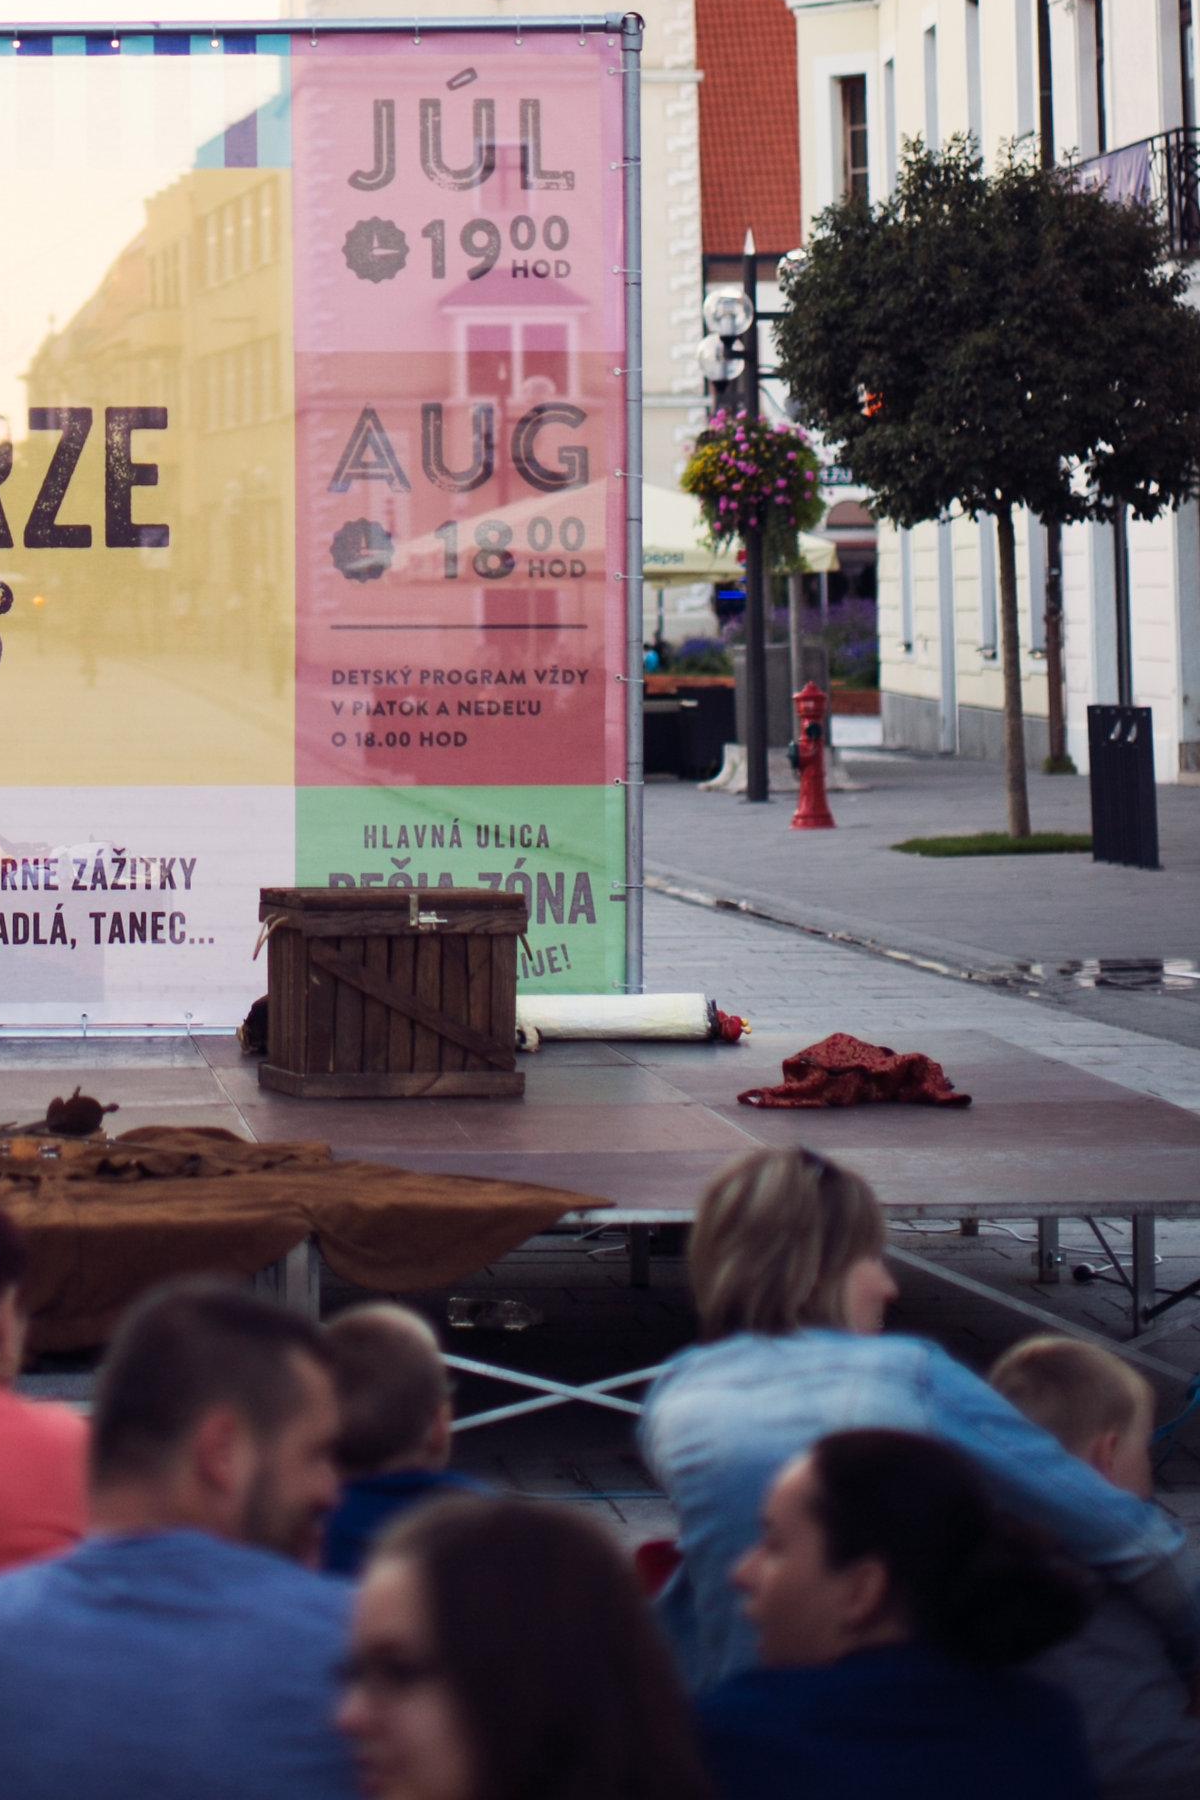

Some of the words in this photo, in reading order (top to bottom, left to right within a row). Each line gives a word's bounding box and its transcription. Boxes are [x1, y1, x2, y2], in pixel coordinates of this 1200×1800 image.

[347, 66, 575, 192] JÚL
[511, 259, 572, 279] HOD
[327, 402, 589, 494] AUG
[528, 559, 587, 579] HOD
[331, 665, 412, 685] DETSKÝ
[419, 669, 527, 685] PROGRAM
[534, 665, 590, 685] VŽDY
[331, 701, 345, 716] V
[352, 700, 429, 716] PIATOK
[436, 701, 450, 716] A
[457, 699, 542, 716] NEDEĽU
[331, 732, 347, 747] O
[355, 731, 411, 747] 18.00
[419, 732, 468, 747] HOD
[363, 818, 463, 849] HLAVNÁ
[476, 824, 550, 849] ULICA
[71, 848, 197, 891] ZÁŽITKY
[88, 911, 215, 945] TANEC...
[516, 943, 572, 980] IJE!
